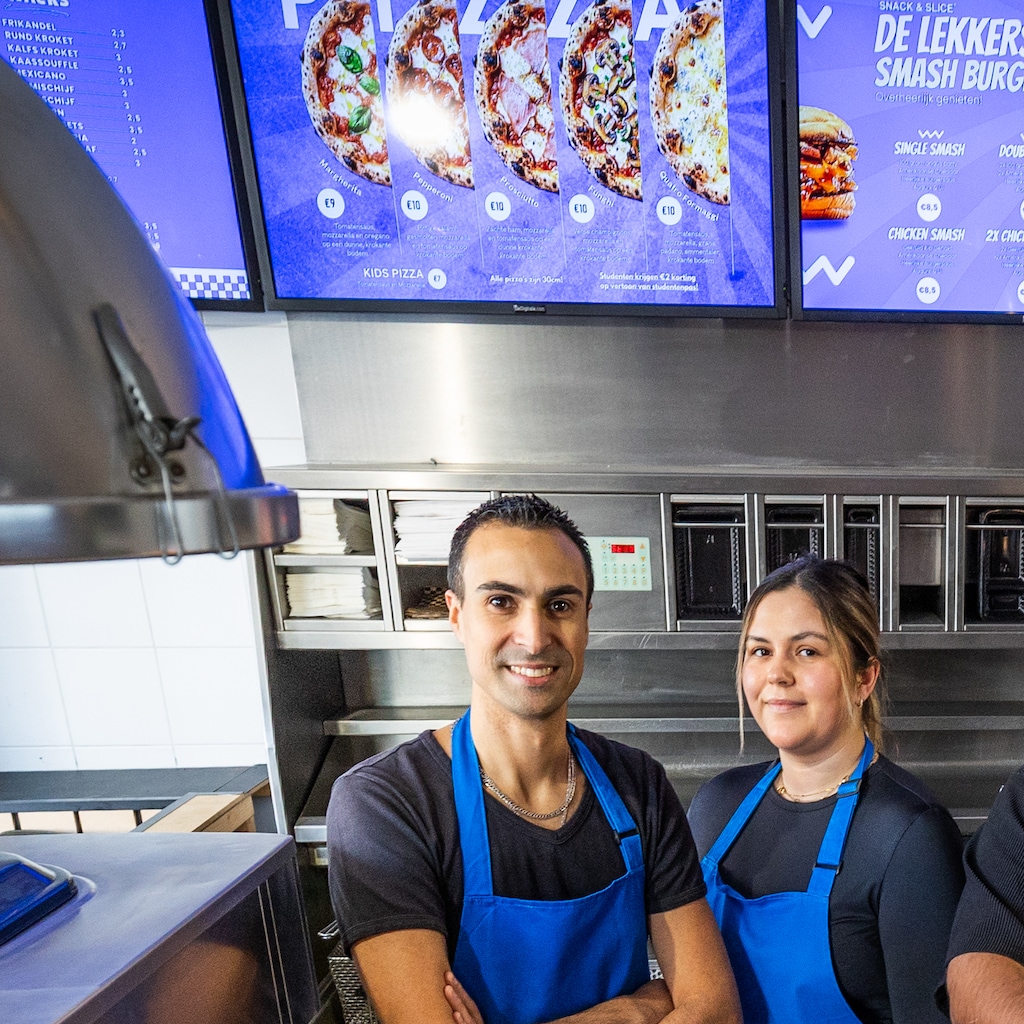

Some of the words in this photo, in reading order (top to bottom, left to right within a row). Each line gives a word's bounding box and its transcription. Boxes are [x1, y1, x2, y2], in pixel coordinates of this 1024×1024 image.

[879, 1, 912, 11] SNACK
[2, 19, 56, 31] FRIKANDEL
[5, 31, 32, 40] RUND
[35, 34, 73, 45] KROKET
[874, 14, 913, 53] DE
[8, 44, 38, 53] KALFS
[40, 46, 78, 58] KROKET
[114, 41, 126, 49] 2,7
[10, 56, 78, 69] KAASSOUFFLE
[874, 57, 958, 89] SMASH
[875, 92, 934, 106] Overheerlijk
[937, 95, 983, 106] genieten!
[894, 141, 928, 155] SINGLE
[930, 143, 965, 156] SMASH
[319, 159, 362, 197] Margherita
[413, 172, 453, 202] Pepperoni
[501, 176, 539, 208] Prosciutto
[588, 185, 615, 208] Funghi
[325, 199, 335, 208] €9
[407, 200, 420, 210] €10
[491, 202, 503, 211] €10
[575, 205, 587, 213] €10
[683, 195, 719, 222] Formaggi
[663, 206, 675, 215] €10
[888, 228, 929, 240] CHICKEN
[931, 229, 965, 241] SMASH
[986, 230, 999, 242] 2X
[364, 268, 389, 278] KIDS
[392, 268, 424, 279] PIZZA
[600, 272, 633, 280] Studenten
[635, 273, 658, 282] krijgen
[660, 273, 669, 281] €2
[672, 274, 696, 282] korting
